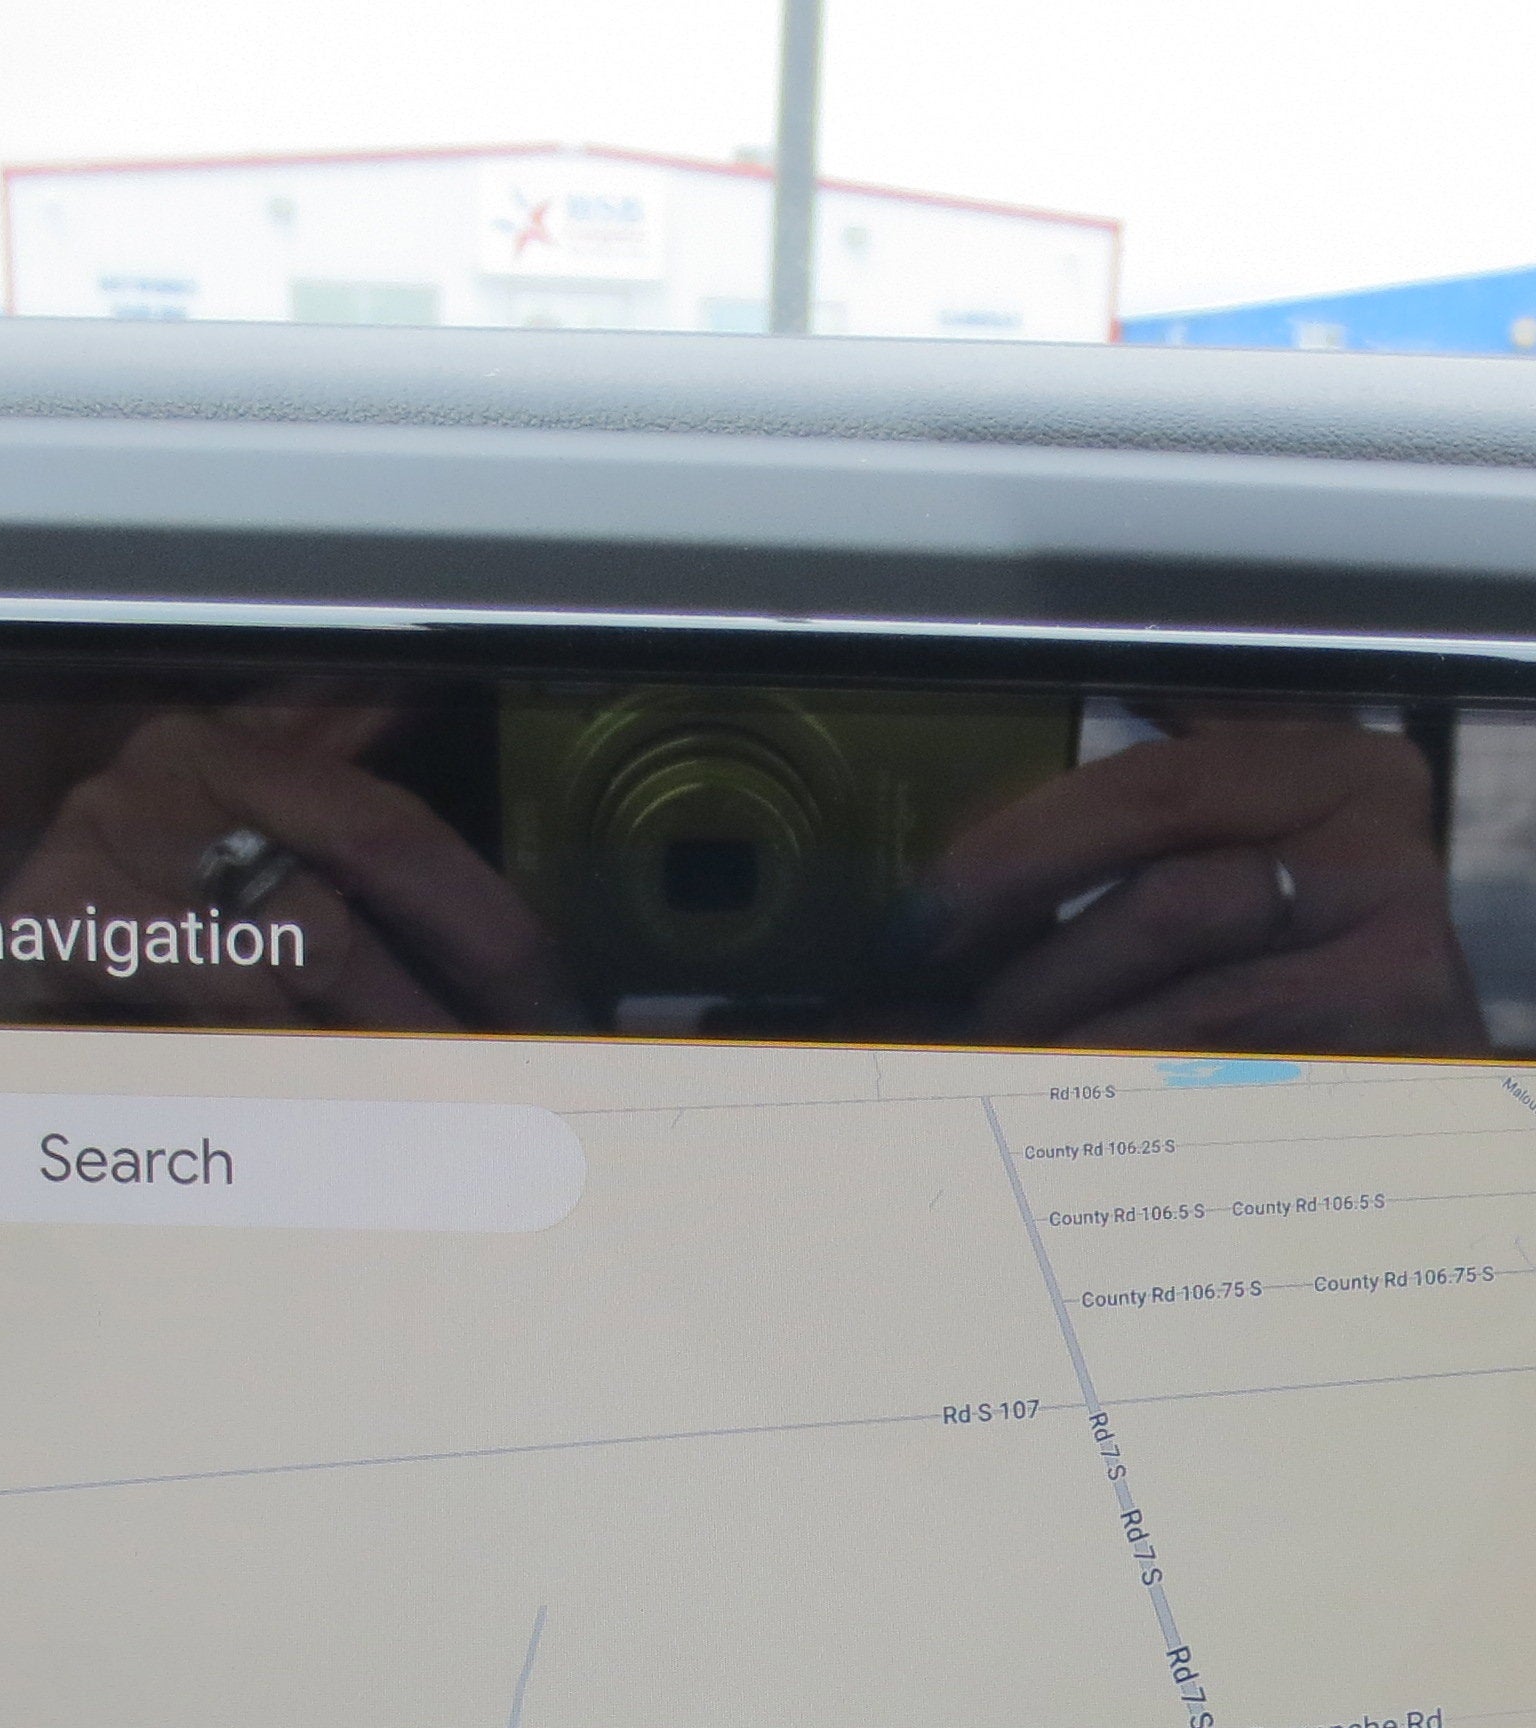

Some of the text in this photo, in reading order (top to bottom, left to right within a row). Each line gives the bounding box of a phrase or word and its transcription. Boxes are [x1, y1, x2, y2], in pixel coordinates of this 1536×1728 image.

[1050, 1085, 1116, 1100] Rd 106 S
[38, 1132, 234, 1186] Search
[1025, 1139, 1176, 1161] County Rd 106.25 S
[1049, 1203, 1206, 1229] County Rd 106.5 S
[1232, 1193, 1386, 1218] County Rd 106.5 S
[1313, 1266, 1495, 1295] County Rd 106.75 S
[1081, 1280, 1264, 1310] County Rd 106.75 S
[942, 1399, 1040, 1425] Rd S 107
[1088, 1411, 1127, 1482] Rd 7 S
[1120, 1508, 1163, 1587] Rd 7 S
[1166, 1645, 1199, 1685] Rd
[1180, 1686, 1208, 1705] 7
